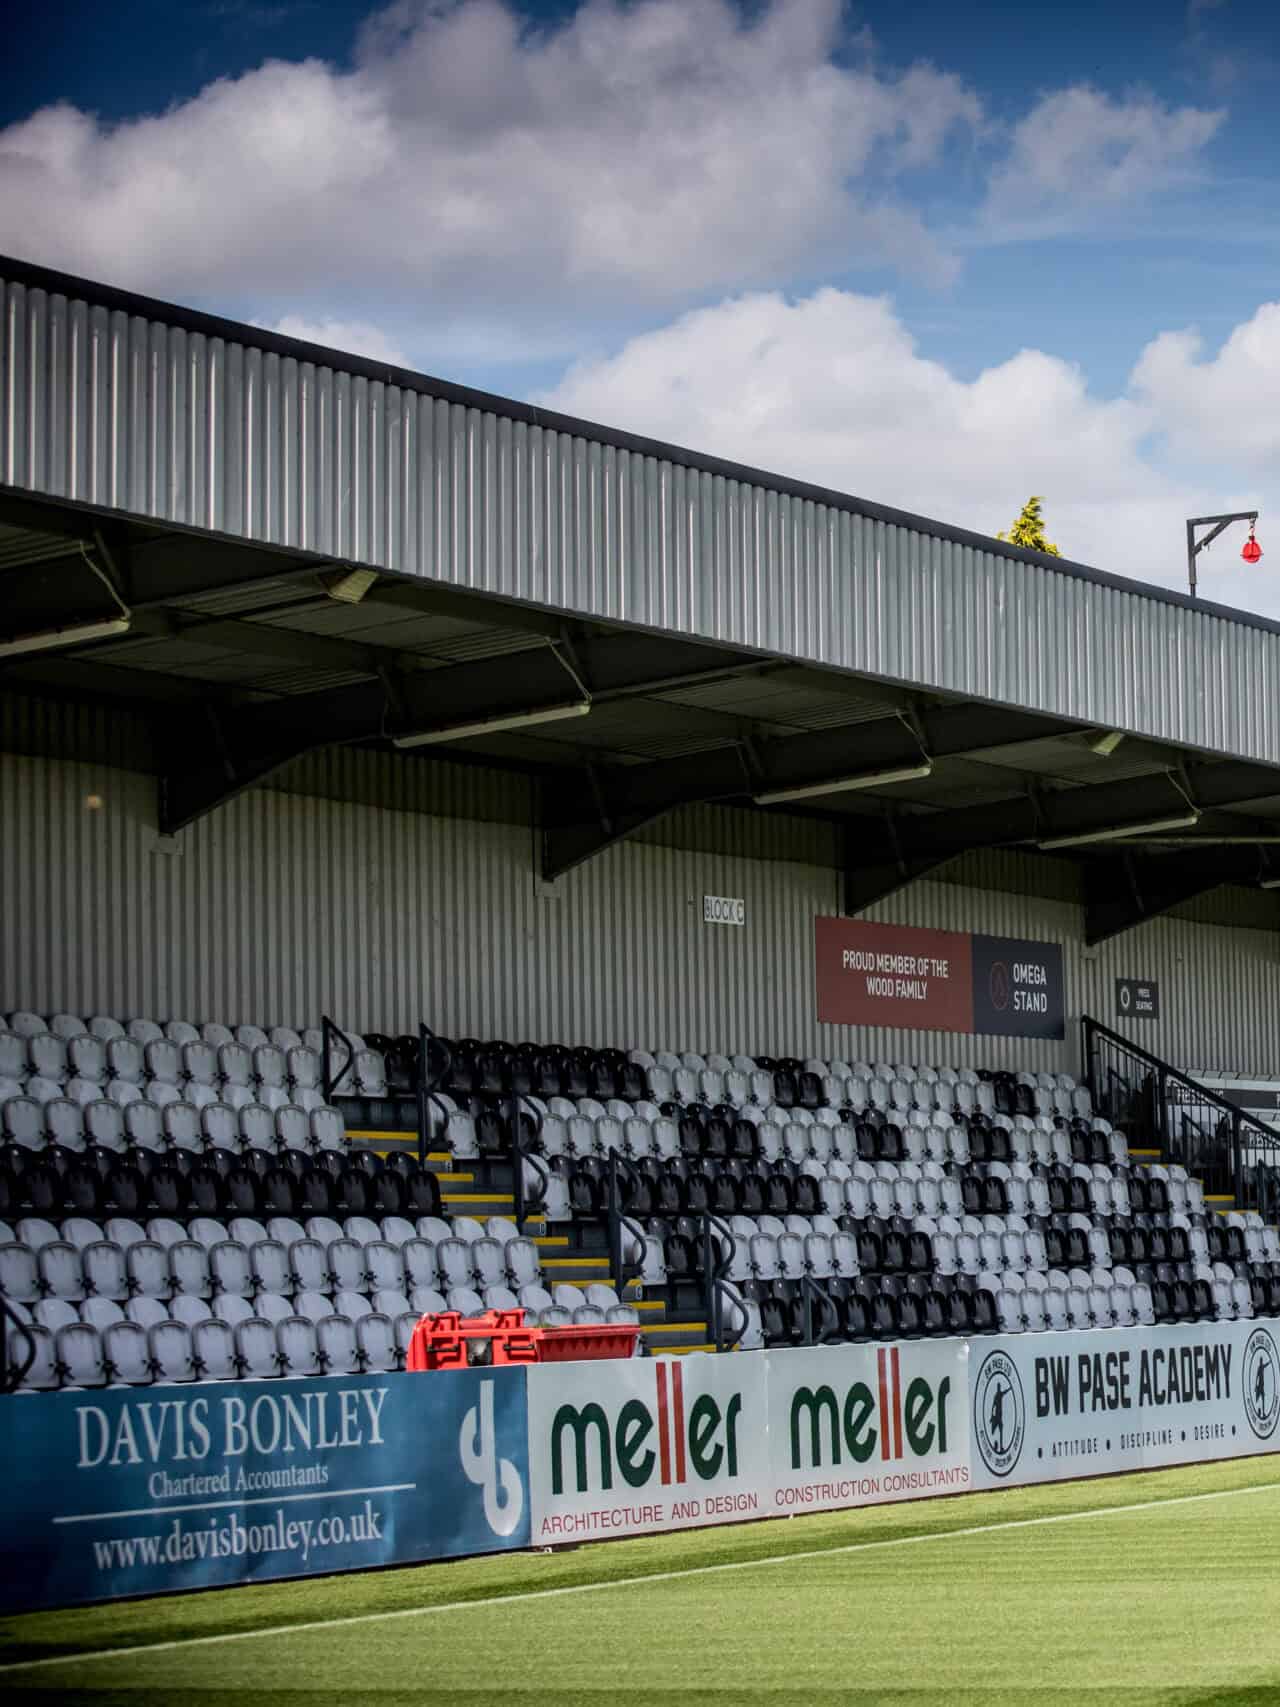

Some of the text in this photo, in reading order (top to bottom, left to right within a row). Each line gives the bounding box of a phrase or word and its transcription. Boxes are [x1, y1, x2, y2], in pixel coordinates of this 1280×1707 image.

[842, 949, 949, 978] PROUD MEMBER OF THE
[1013, 962, 1047, 986] OMEGA
[866, 976, 928, 1000] WOOD FAMILY
[1013, 991, 1047, 1013] STAND
[1034, 1343, 1233, 1417] BW PASE ACADEMY
[76, 1387, 389, 1468] DAVIS BONLEY
[551, 1361, 741, 1495] meller
[791, 1347, 951, 1469] meller
[1052, 1423, 1225, 1458] ATTITUDE DISCIPLINE DESIRE
[149, 1462, 329, 1500] Chartered Accountants
[775, 1466, 969, 1507] CONSTRUCTION CONSULTANTS
[541, 1492, 758, 1536] ARCHITECTURE AND DESIGN
[93, 1502, 383, 1571] www.davisbonley.co.uk
